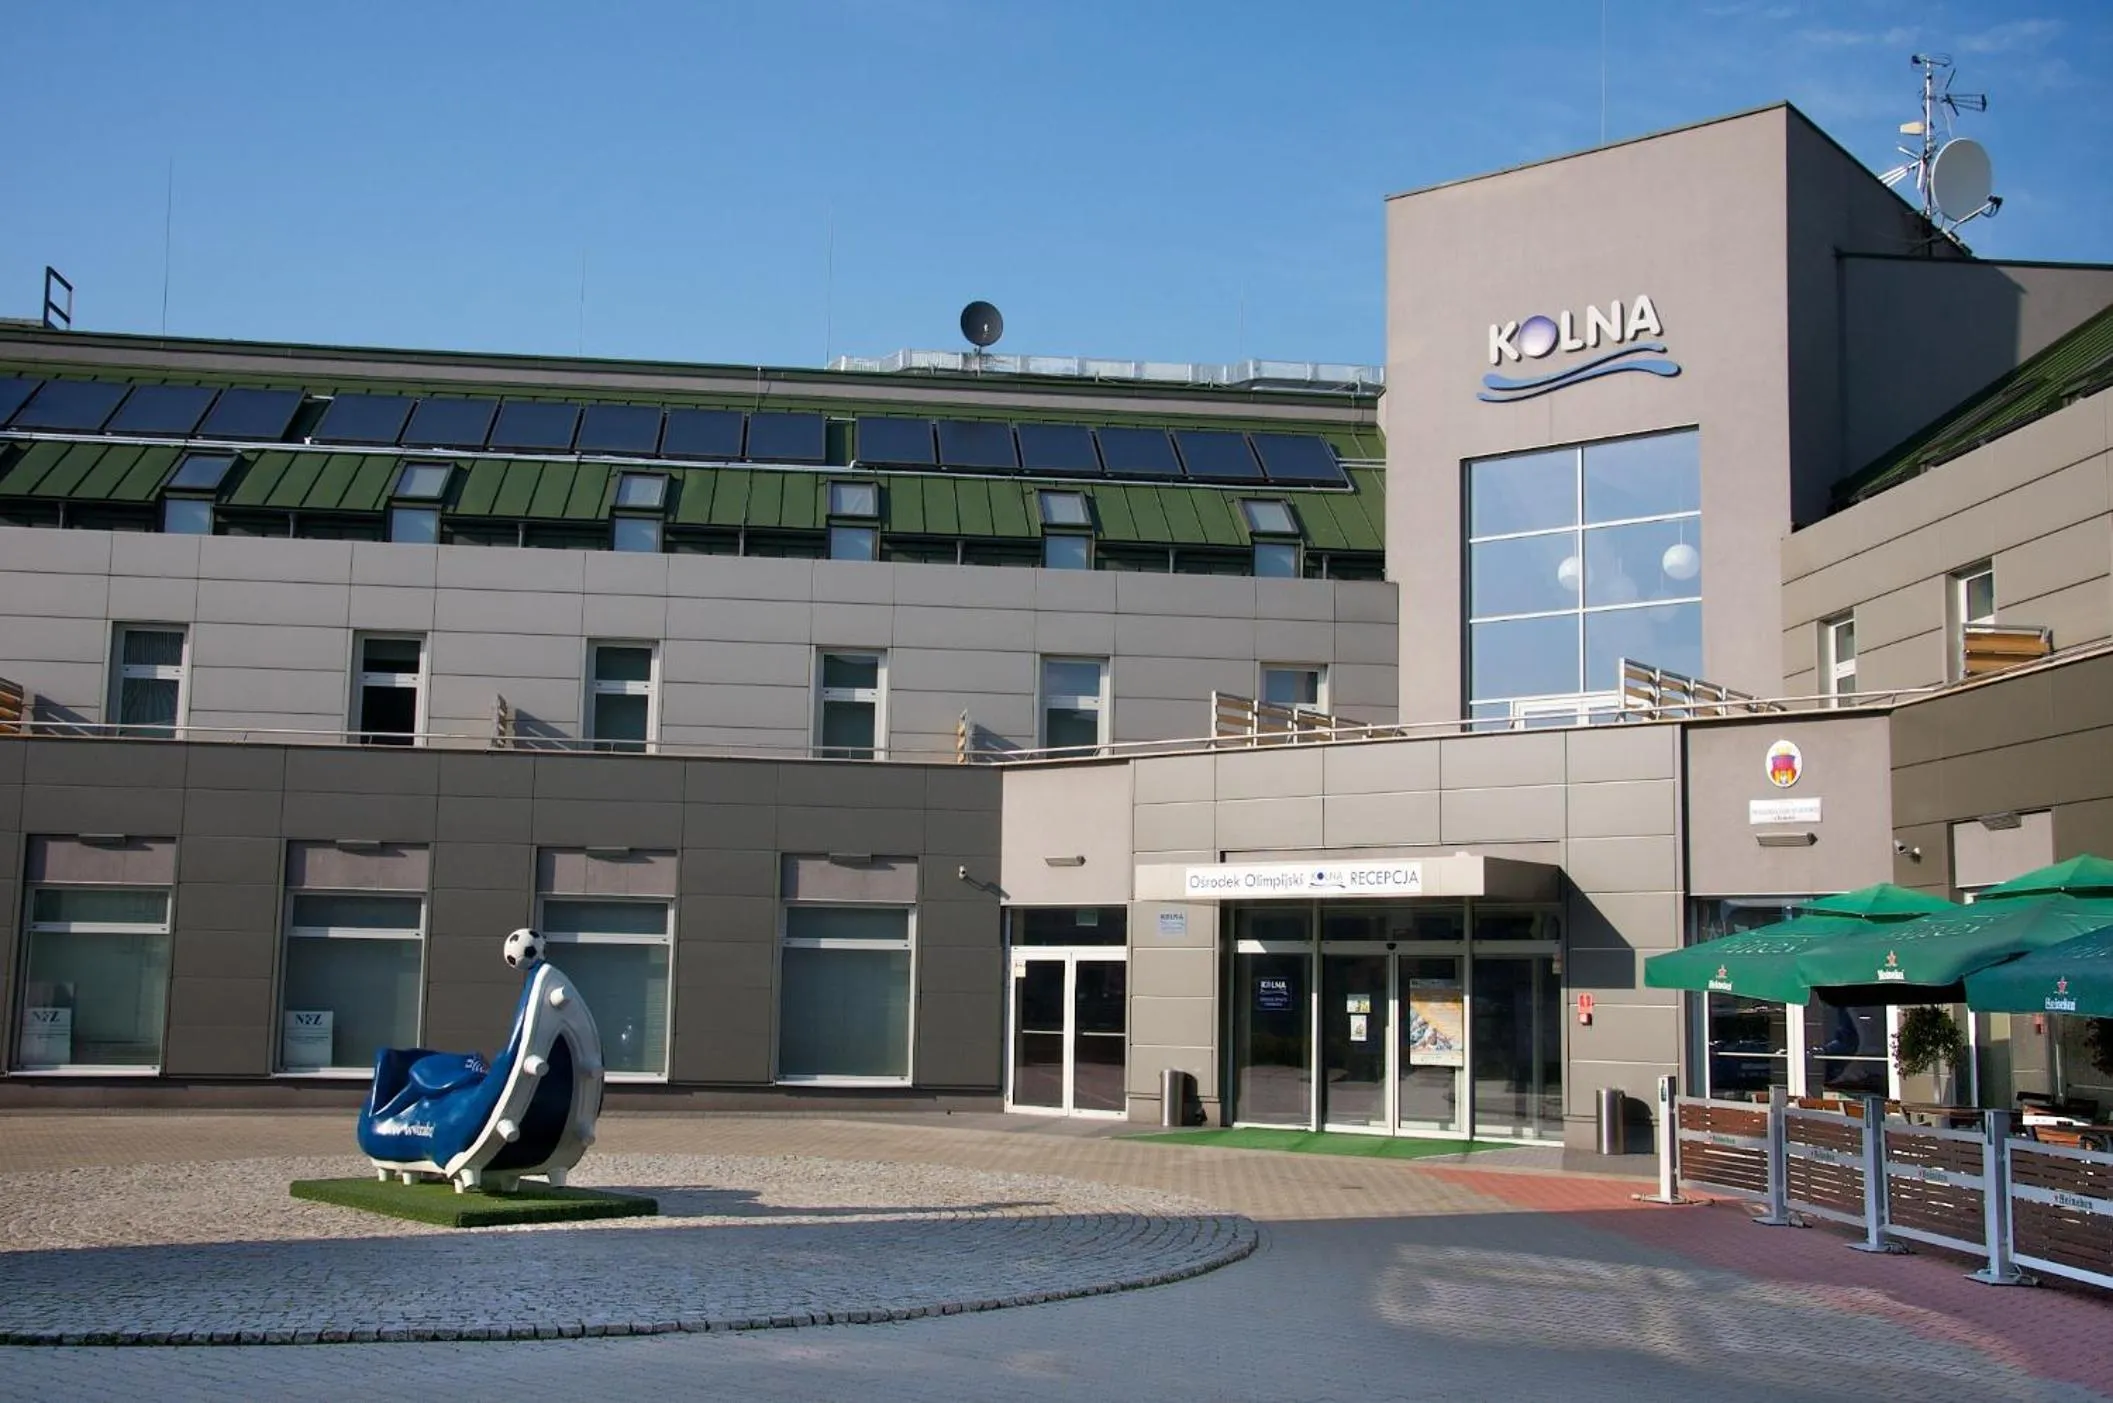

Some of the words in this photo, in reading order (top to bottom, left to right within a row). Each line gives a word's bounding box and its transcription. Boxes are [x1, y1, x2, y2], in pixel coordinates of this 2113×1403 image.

[1488, 294, 1664, 365] KOLNA
[1190, 873, 1240, 889] Ośrodek
[1244, 872, 1304, 890] Olimpijski
[1350, 870, 1419, 886] RECEPCJA
